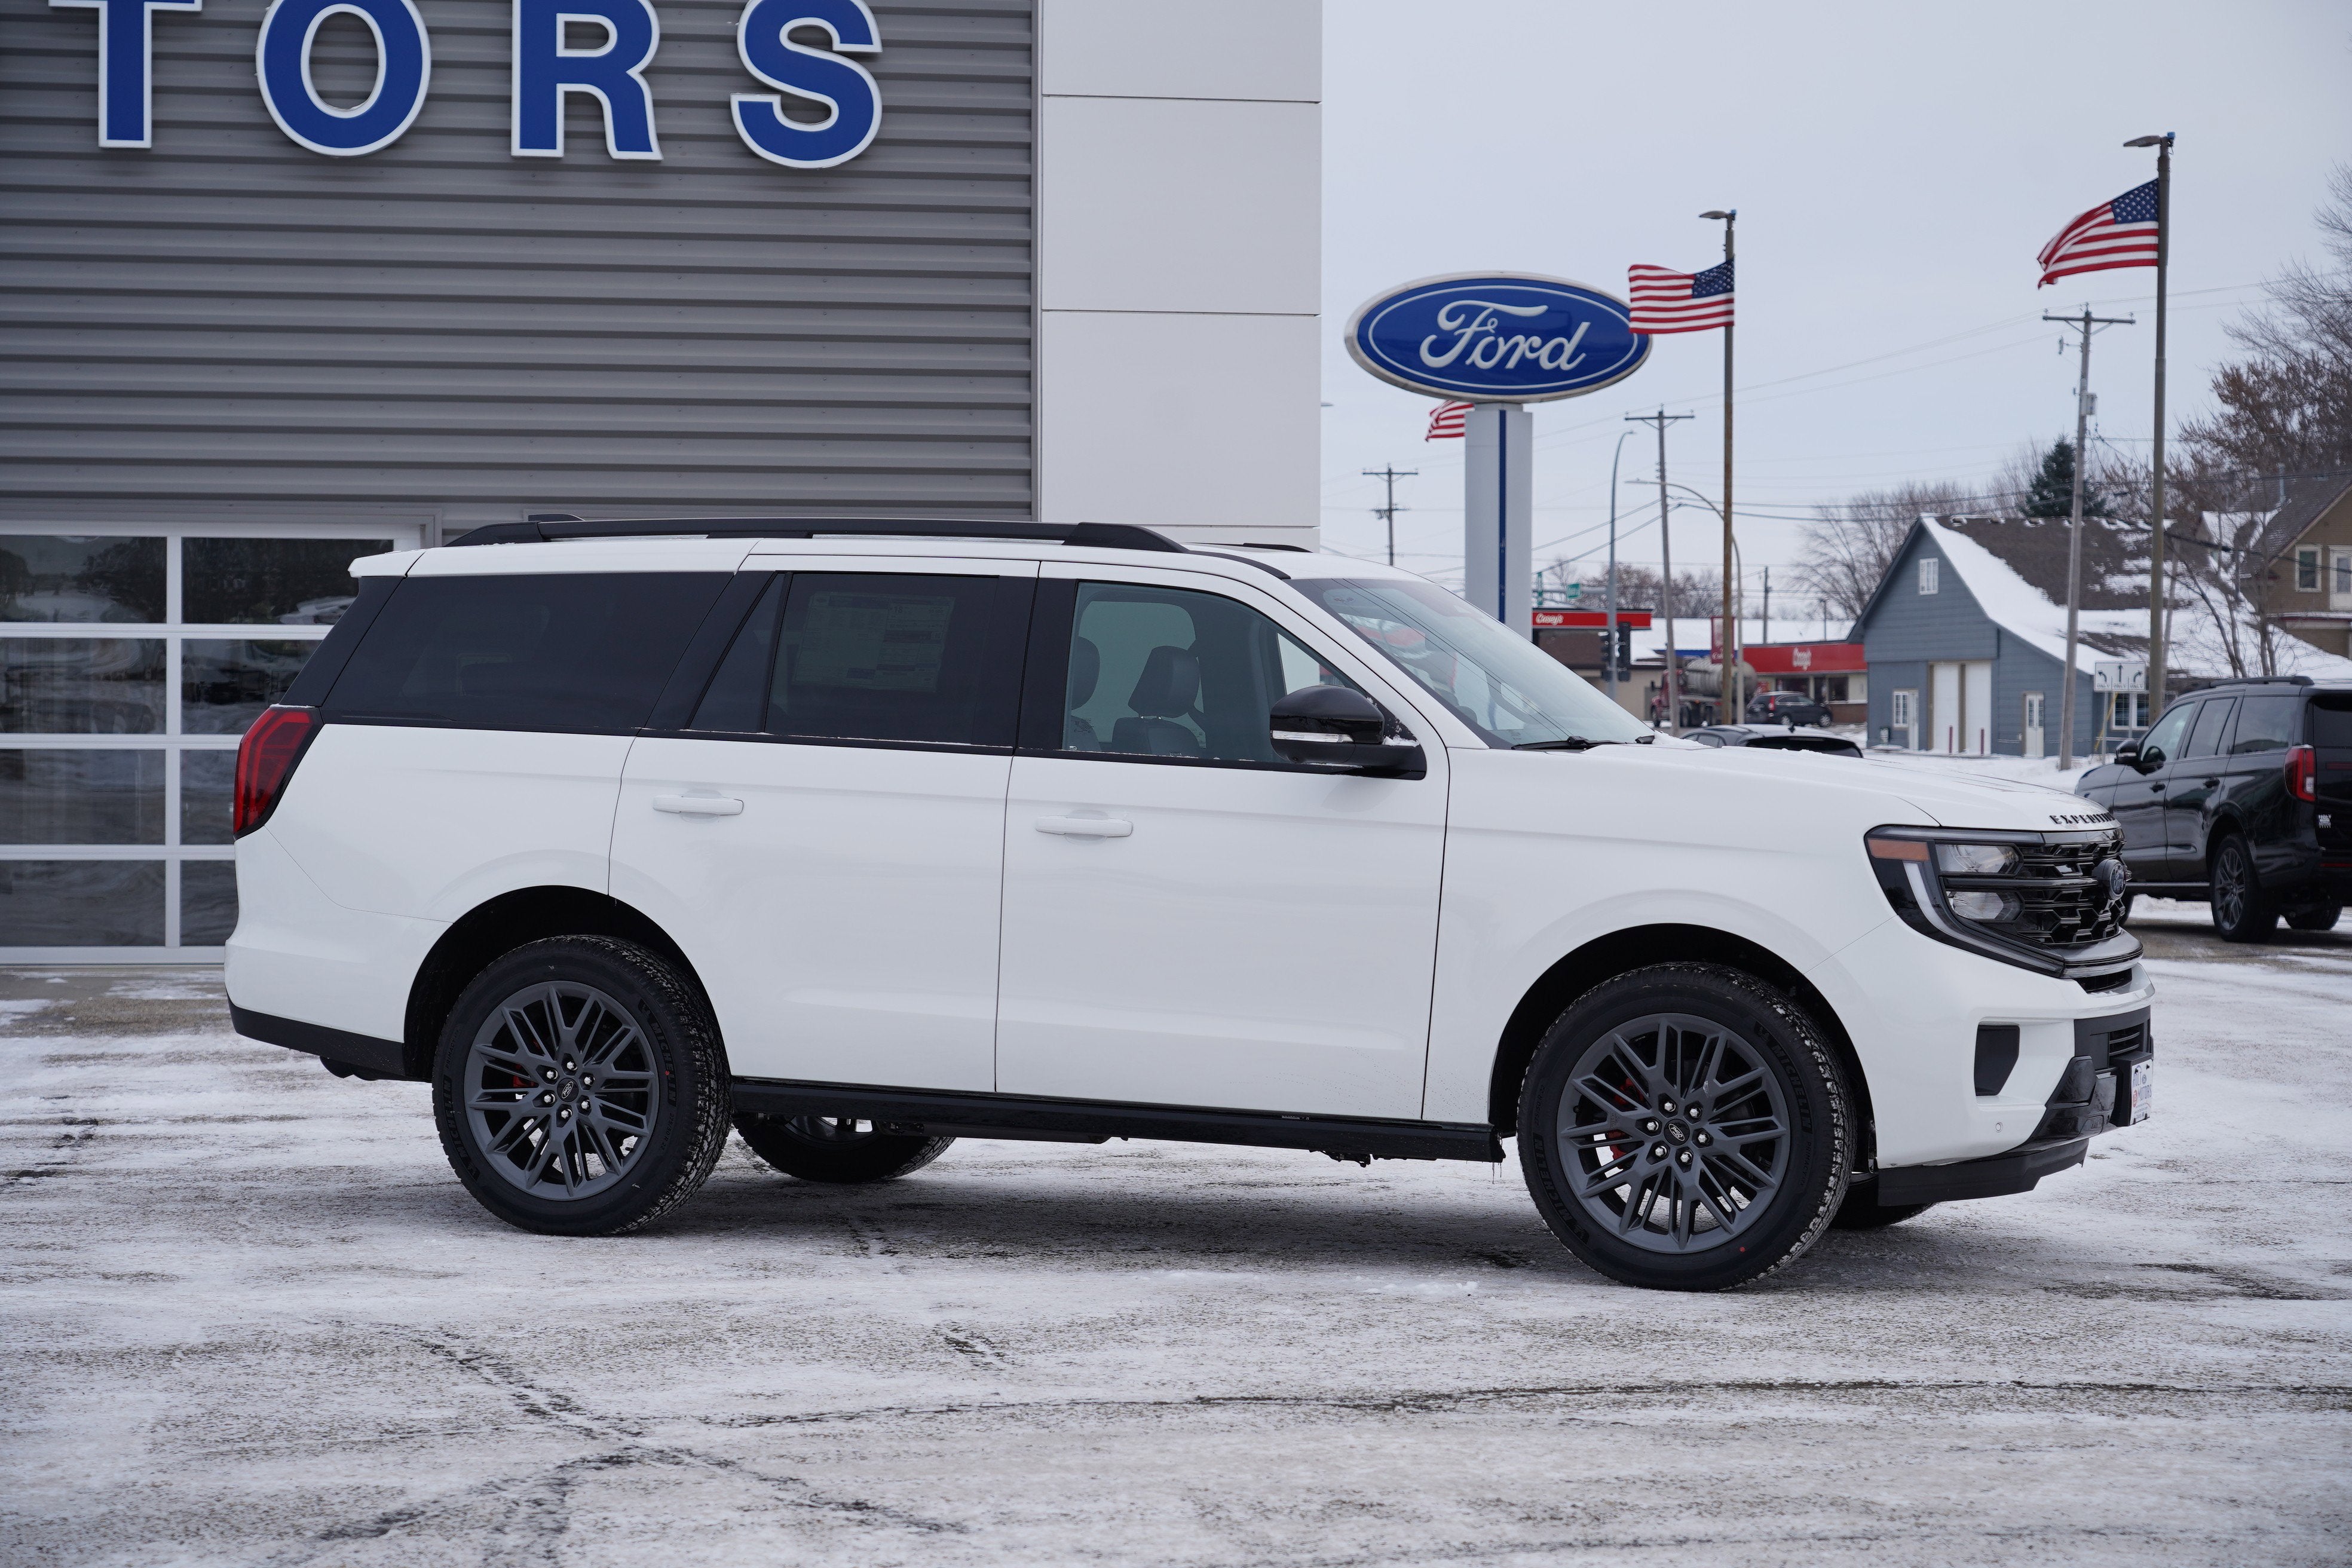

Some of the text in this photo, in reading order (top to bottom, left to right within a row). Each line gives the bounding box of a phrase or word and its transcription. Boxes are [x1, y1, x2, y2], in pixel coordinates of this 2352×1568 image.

[48, 0, 883, 169] TORS
[1419, 299, 1591, 371] Ford
[1536, 613, 1564, 626] Casey's
[651, 1022, 676, 1102] MICHELIN
[1772, 1043, 1813, 1129] MICHELIN
[1534, 1135, 1574, 1223] MICHELIN
